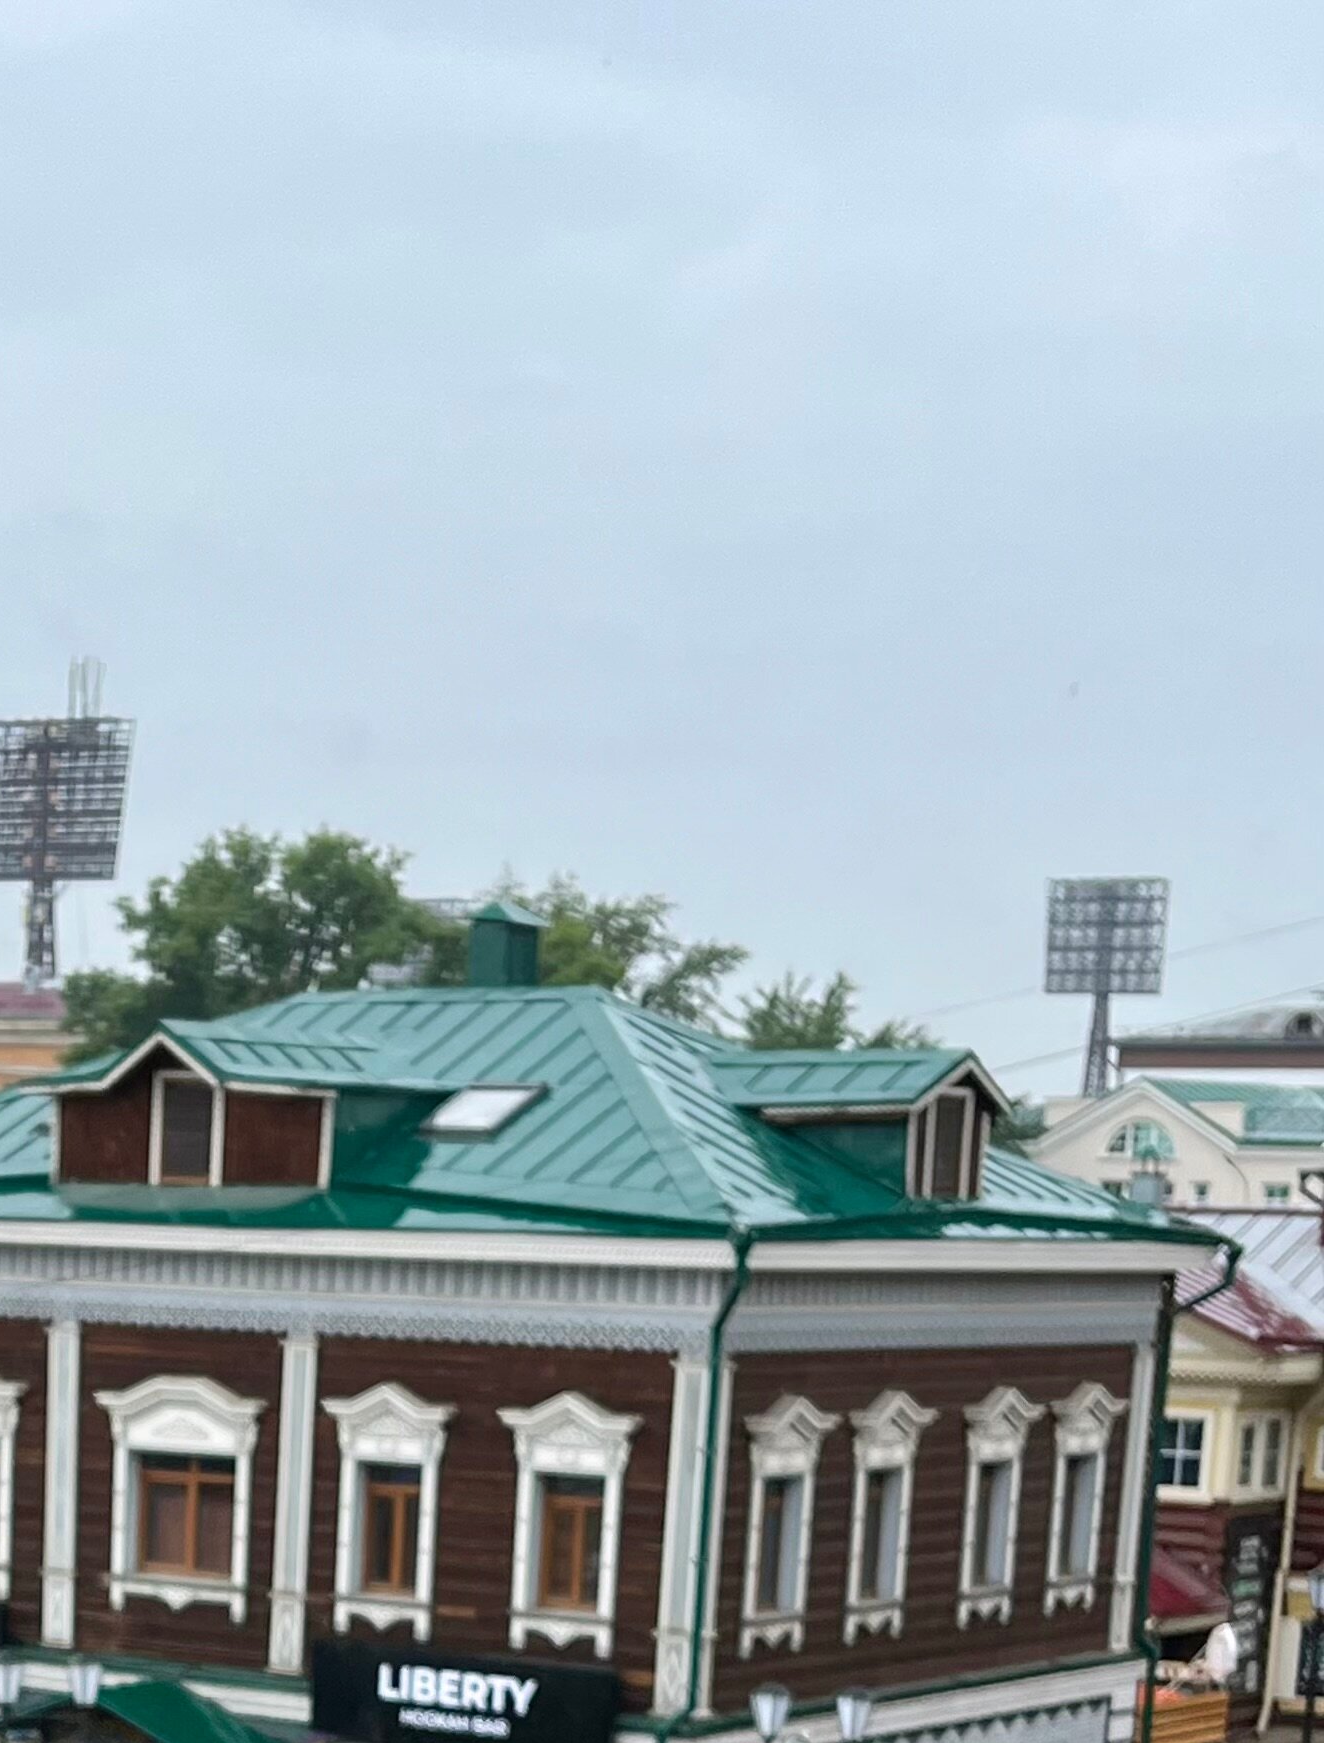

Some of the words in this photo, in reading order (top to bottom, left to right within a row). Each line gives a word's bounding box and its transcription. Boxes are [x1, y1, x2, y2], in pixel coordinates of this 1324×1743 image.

[377, 1661, 539, 1717] LIBERTY
[398, 1707, 470, 1732] HOOKAH
[472, 1716, 511, 1739] BAR
